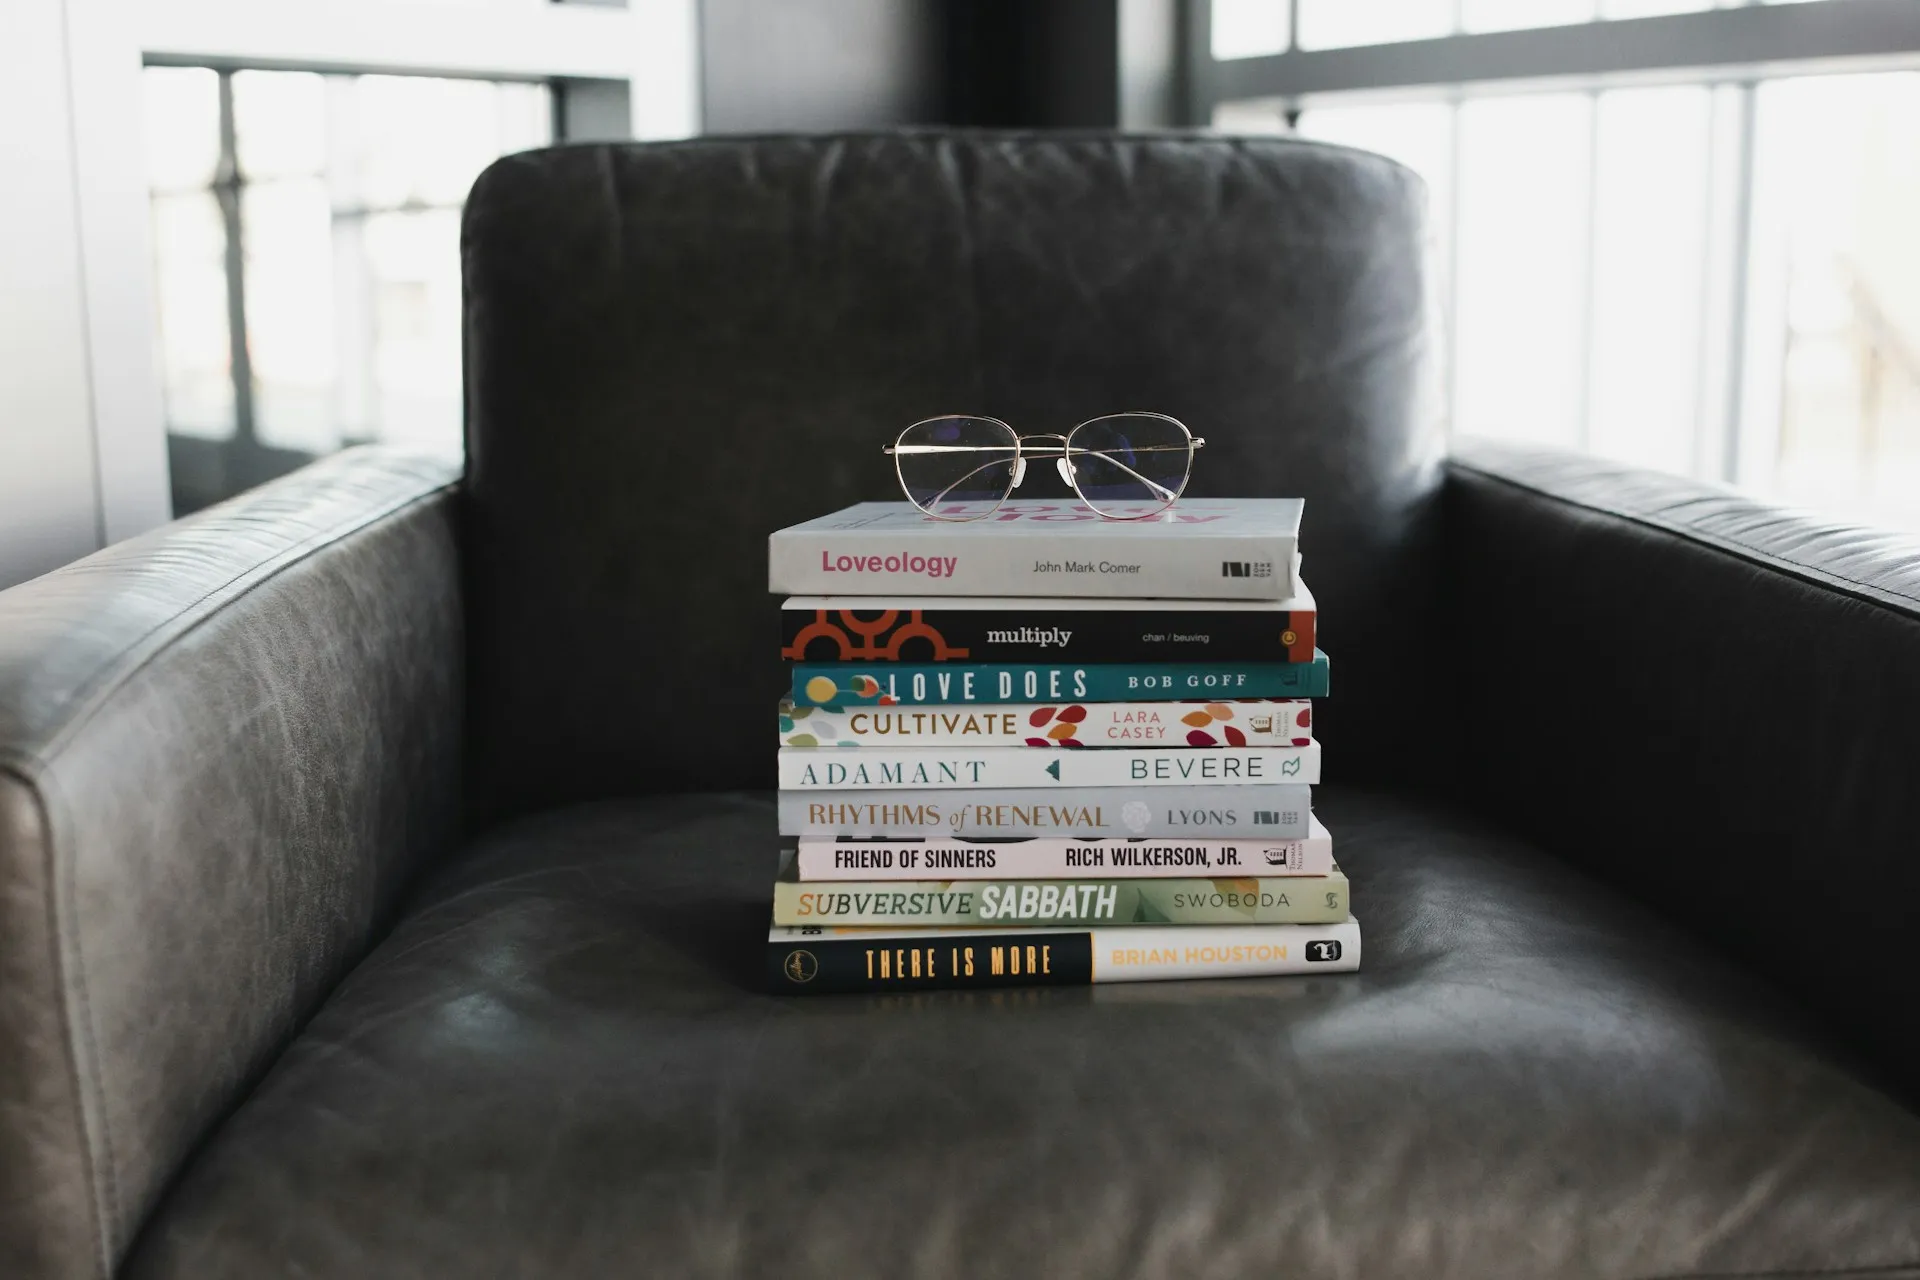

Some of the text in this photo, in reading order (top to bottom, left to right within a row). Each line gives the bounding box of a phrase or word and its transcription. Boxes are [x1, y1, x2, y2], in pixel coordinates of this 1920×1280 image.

[823, 551, 957, 577] Loveology
[1033, 561, 1141, 573] John Mark Comer
[987, 627, 1072, 647] multiply
[1143, 633, 1165, 642] chan
[1173, 634, 1209, 643] beuving
[889, 669, 1087, 701] LOVE DOES
[1129, 674, 1245, 688] BOB GOFF
[851, 713, 1016, 734] CULTIVATE
[1113, 711, 1160, 723] LARA
[1108, 727, 1165, 738] CASEY
[801, 761, 986, 785] ADAMANT
[1132, 757, 1262, 779] BEVERE
[810, 804, 1109, 833] RHYTHMS of RENEWAL
[1168, 810, 1236, 825] LYONS
[836, 850, 996, 868] FRIEND OF SINNERS
[1066, 847, 1241, 868] RICH WILKERSON, JR.
[797, 885, 1117, 919] SUBVERSIVE SABBATH
[1173, 893, 1291, 909] SWOBODA
[866, 945, 1050, 978] THERE IS MORE
[1112, 945, 1287, 965] BRIAN HOUSTON
